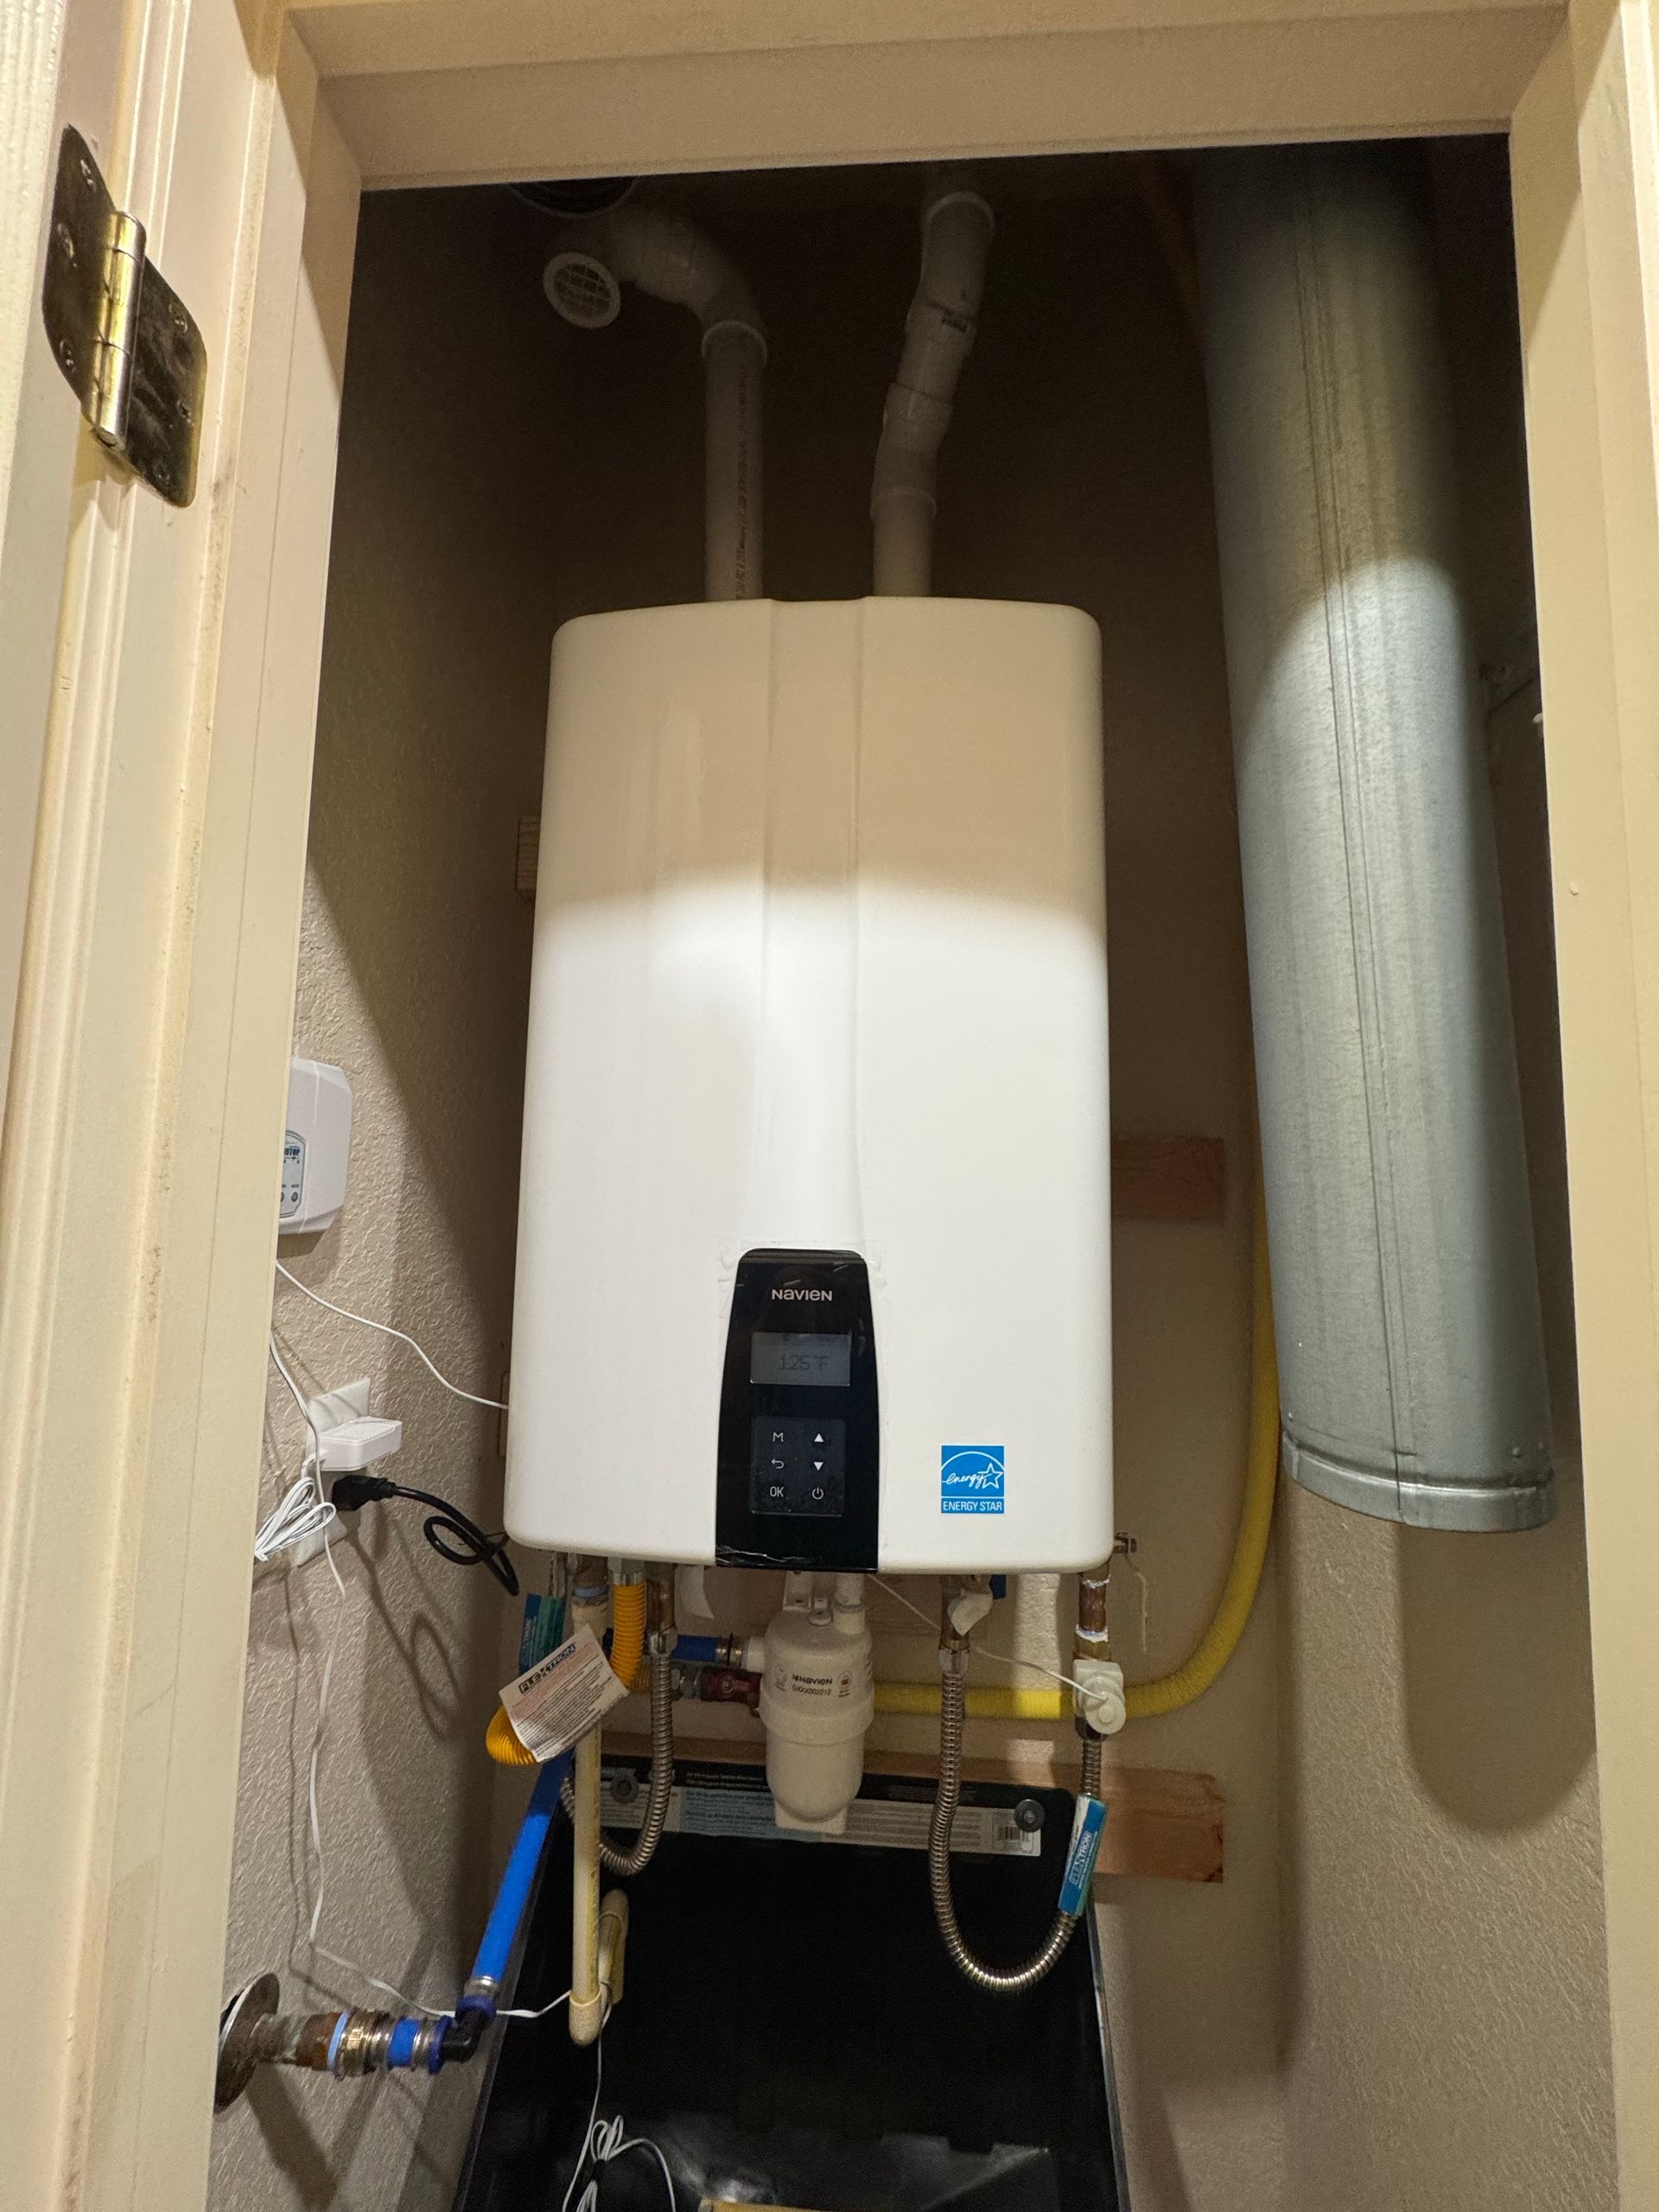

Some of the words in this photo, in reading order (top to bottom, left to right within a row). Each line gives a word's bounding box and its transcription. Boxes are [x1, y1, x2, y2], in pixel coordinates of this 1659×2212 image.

[772, 1432, 784, 1442] M
[769, 1486, 785, 1497] OK
[943, 1501, 978, 1511] ENERGY
[979, 1501, 1002, 1511] STAR
[519, 1643, 575, 1692] FLEXTRON
